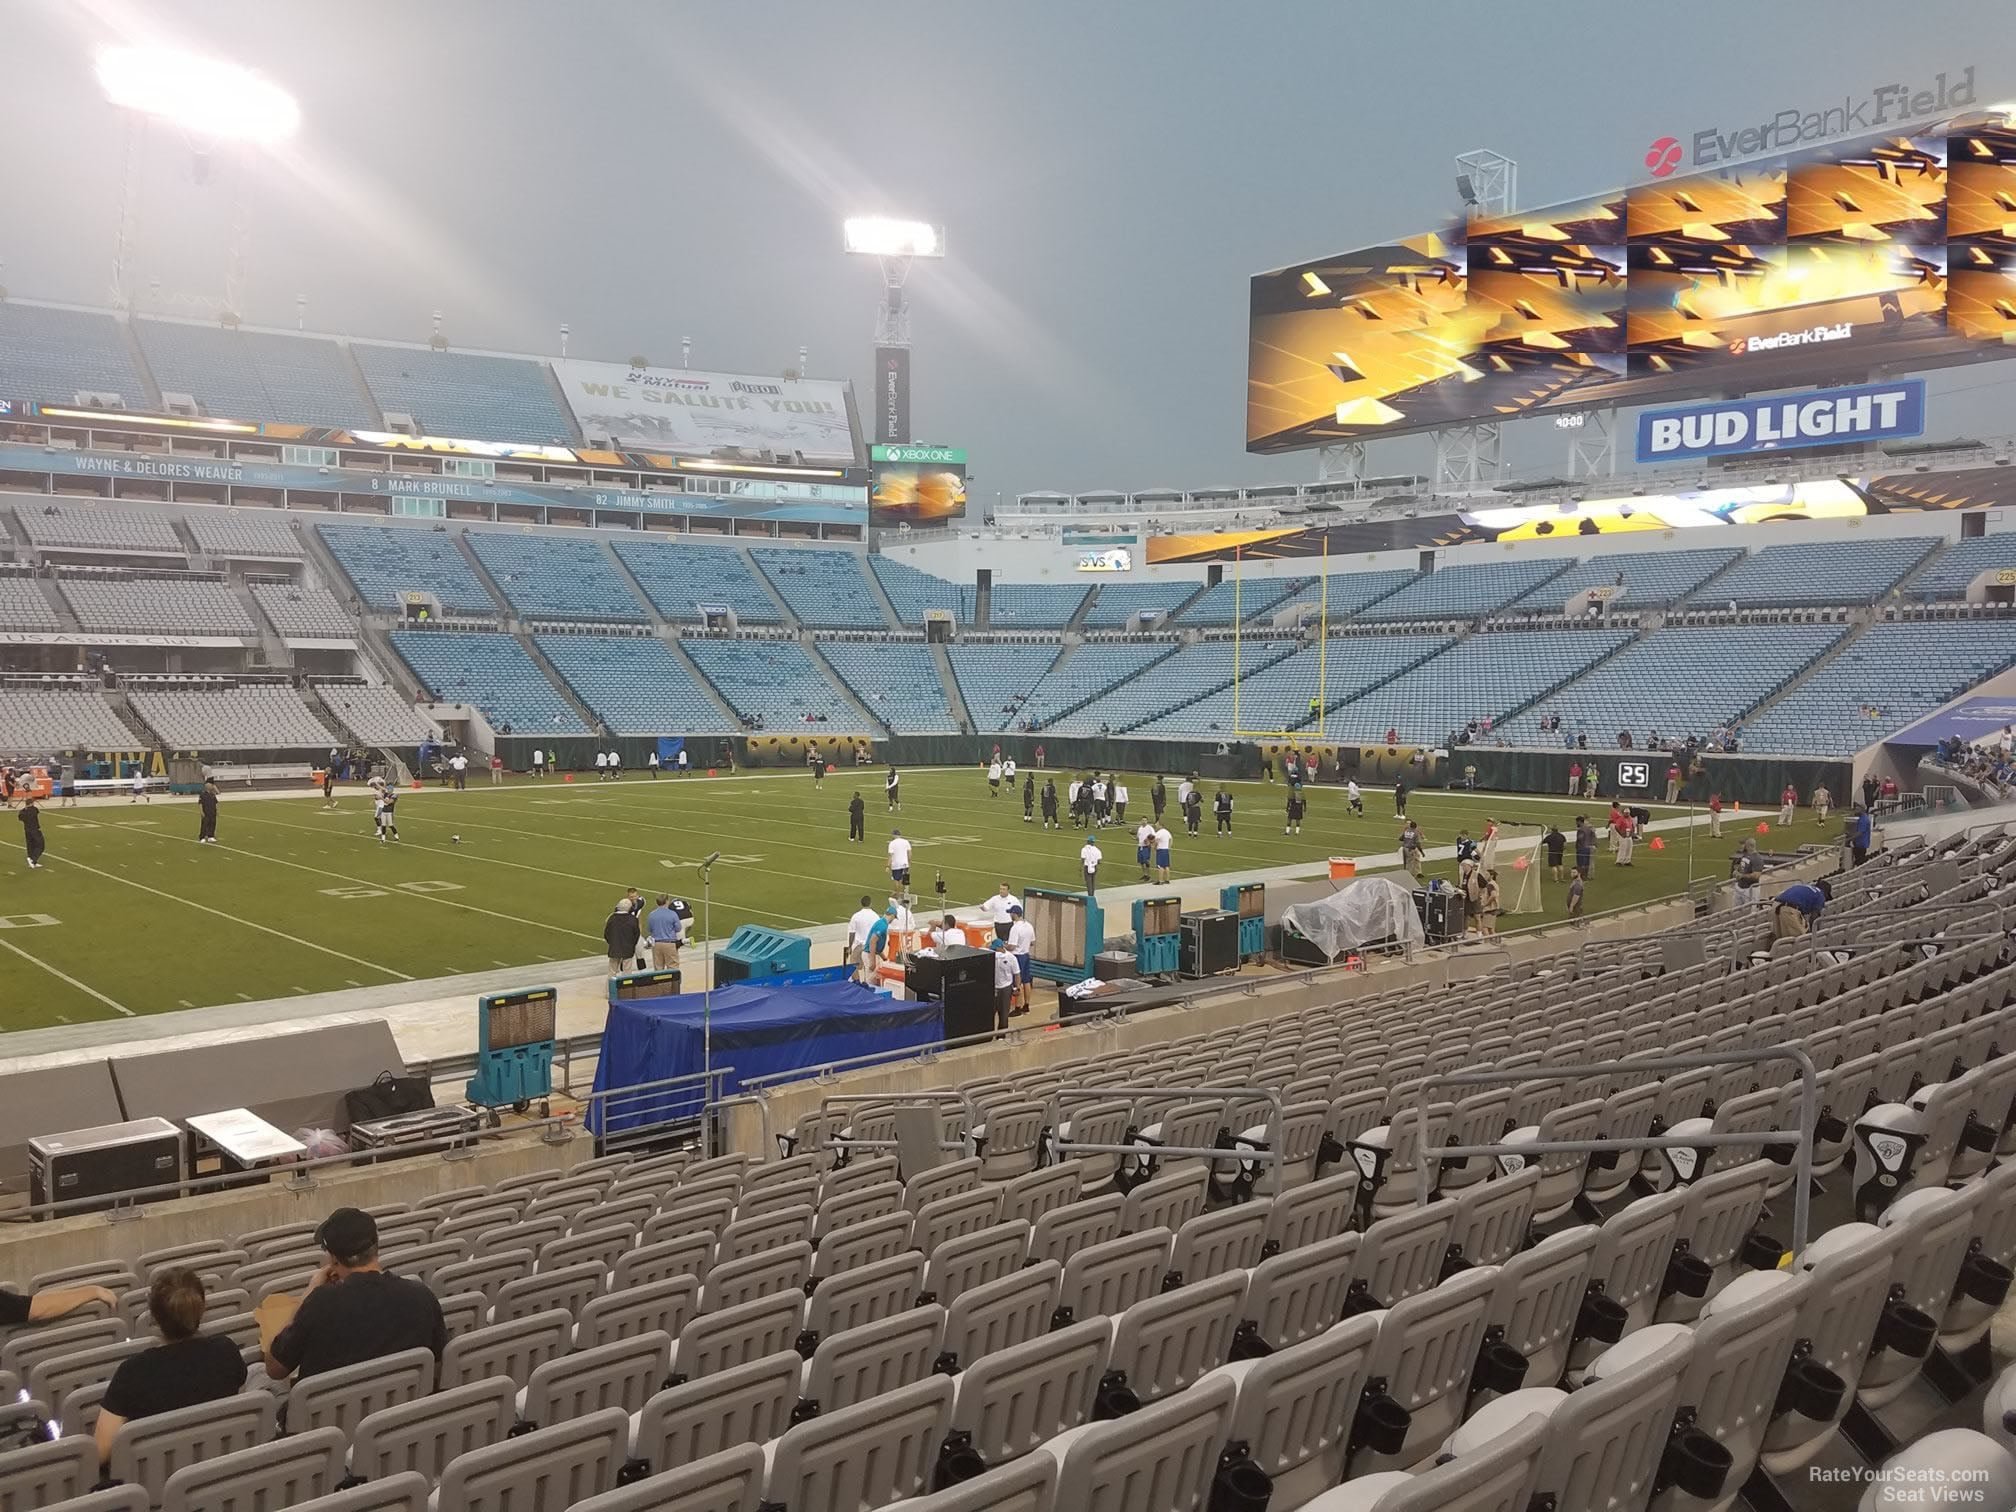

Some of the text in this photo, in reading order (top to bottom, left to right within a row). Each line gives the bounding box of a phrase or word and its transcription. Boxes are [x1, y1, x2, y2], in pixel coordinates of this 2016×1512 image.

[1693, 65, 1976, 166] EverBank Field
[1747, 321, 1853, 352] EverBank Field
[580, 381, 834, 414] WE SALUTE YOU!
[887, 371, 898, 438] EverBank Field
[1651, 392, 1906, 452] BUD LIGHT
[902, 449, 953, 461] XBOX ONE
[75, 456, 119, 472] WAYNE
[124, 460, 132, 473] &
[137, 461, 190, 477] DELORES
[194, 466, 243, 481] WEAVER
[371, 478, 379, 490] 8
[388, 479, 420, 493] MARK
[423, 482, 472, 497] BRUNELL
[596, 494, 608, 505] 82
[616, 495, 644, 508] JIMMY
[647, 497, 675, 509] SMITH
[1999, 572, 2016, 581] 225
[7, 634, 201, 646] US Assure Club
[1622, 765, 1646, 784] 25
[673, 899, 686, 911] 9
